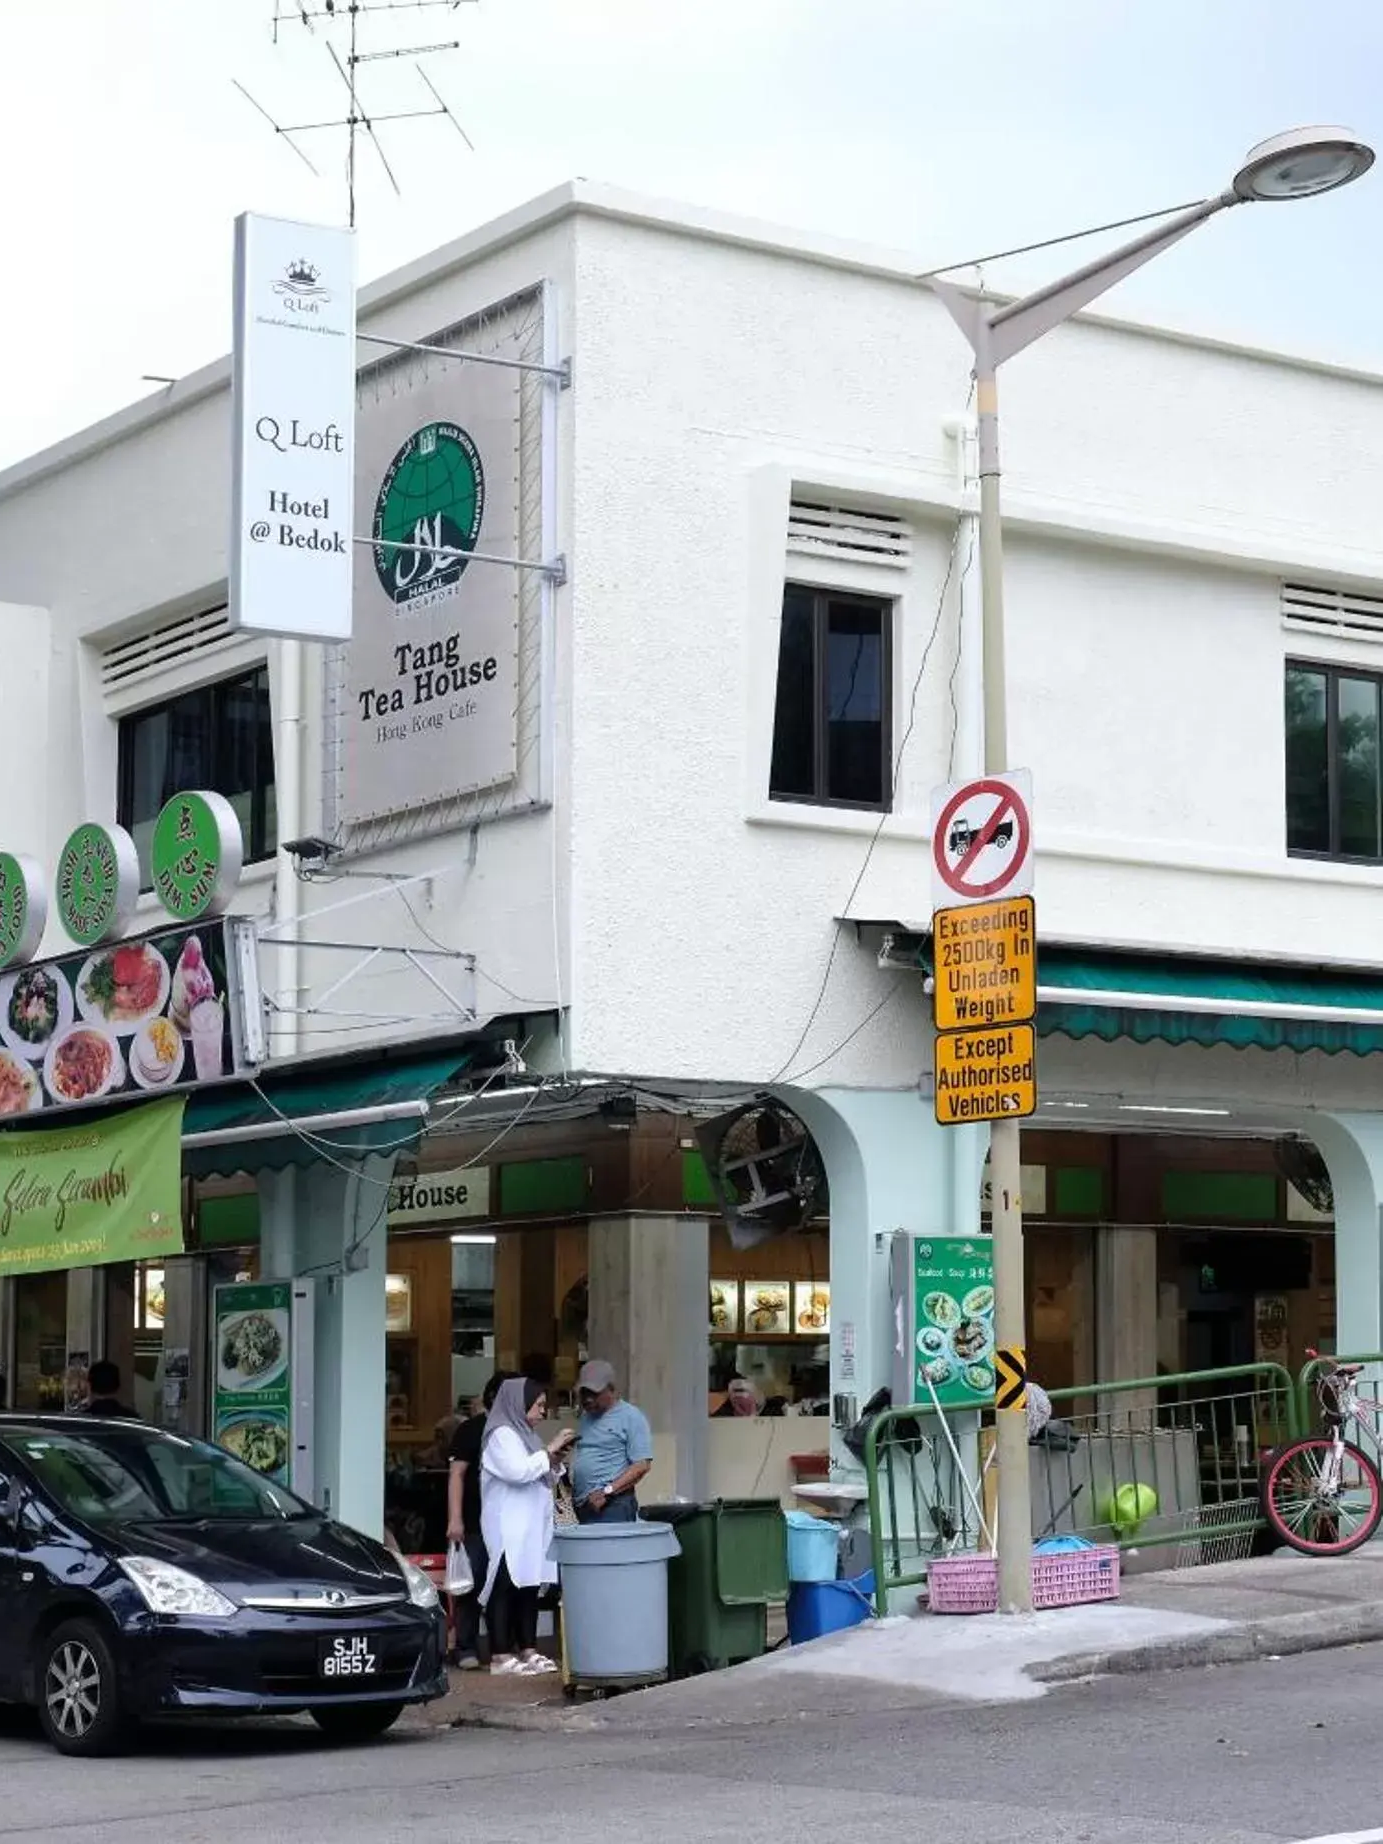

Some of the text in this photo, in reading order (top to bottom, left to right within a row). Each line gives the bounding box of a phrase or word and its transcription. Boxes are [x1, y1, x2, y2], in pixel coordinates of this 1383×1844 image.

[256, 416, 344, 452] Q Loft
[269, 490, 330, 519] Hotel
[250, 521, 347, 554] @ Bedok
[409, 577, 442, 599] HALAL
[394, 633, 460, 676] Tang
[359, 657, 497, 721] Tea House
[377, 723, 407, 743] Hong
[412, 713, 444, 733] Kong
[159, 861, 215, 910] DIM SUM
[939, 907, 1028, 940] Exceeding
[943, 934, 1029, 967] 2500kg In
[949, 967, 1020, 993] Unladen
[955, 996, 1015, 1022] Weight
[955, 1032, 1013, 1060] Except
[938, 1058, 1032, 1091] Authorised
[949, 1089, 1021, 1118] Vehicles
[398, 1184, 468, 1210] House
[333, 1636, 368, 1657] SJH
[324, 1654, 375, 1676] 8155Z
